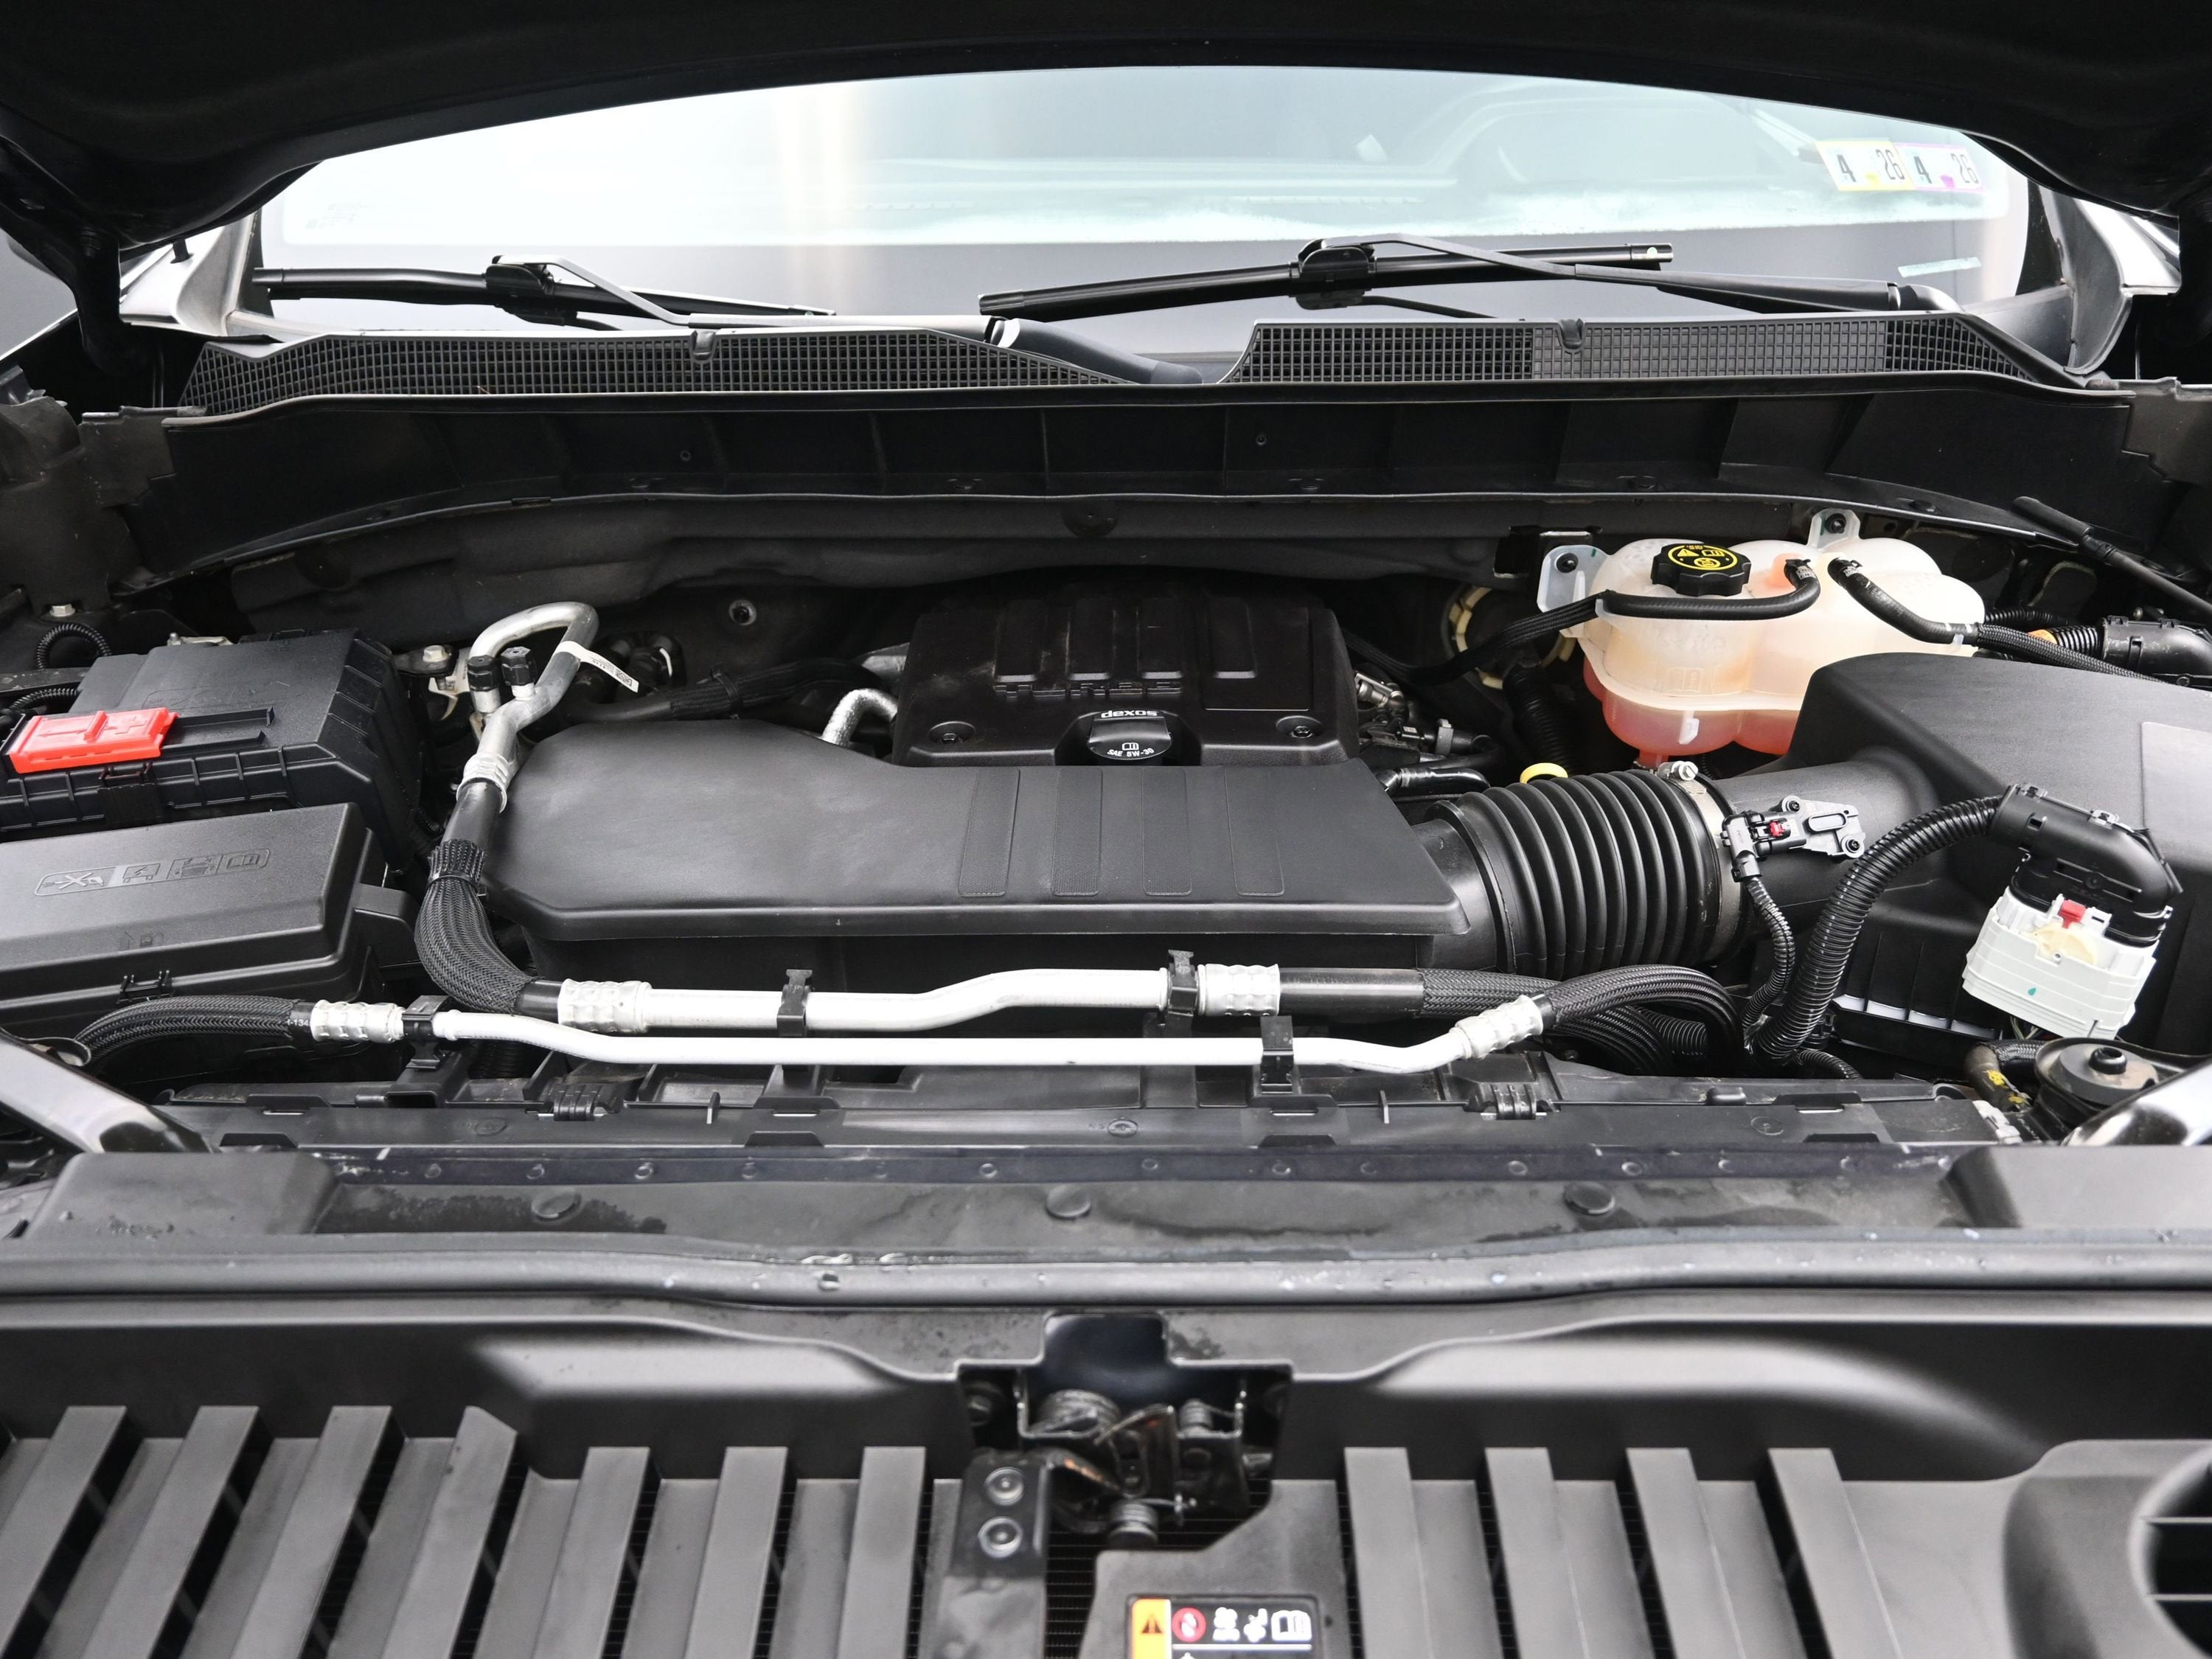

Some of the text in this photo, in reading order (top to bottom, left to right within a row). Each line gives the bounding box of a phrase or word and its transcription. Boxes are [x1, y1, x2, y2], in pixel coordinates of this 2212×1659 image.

[1837, 149, 1905, 182] 4 26
[1913, 153, 1979, 184] 4 26
[1101, 710, 1158, 718] dexos
[1127, 748, 1155, 757] 5W-30
